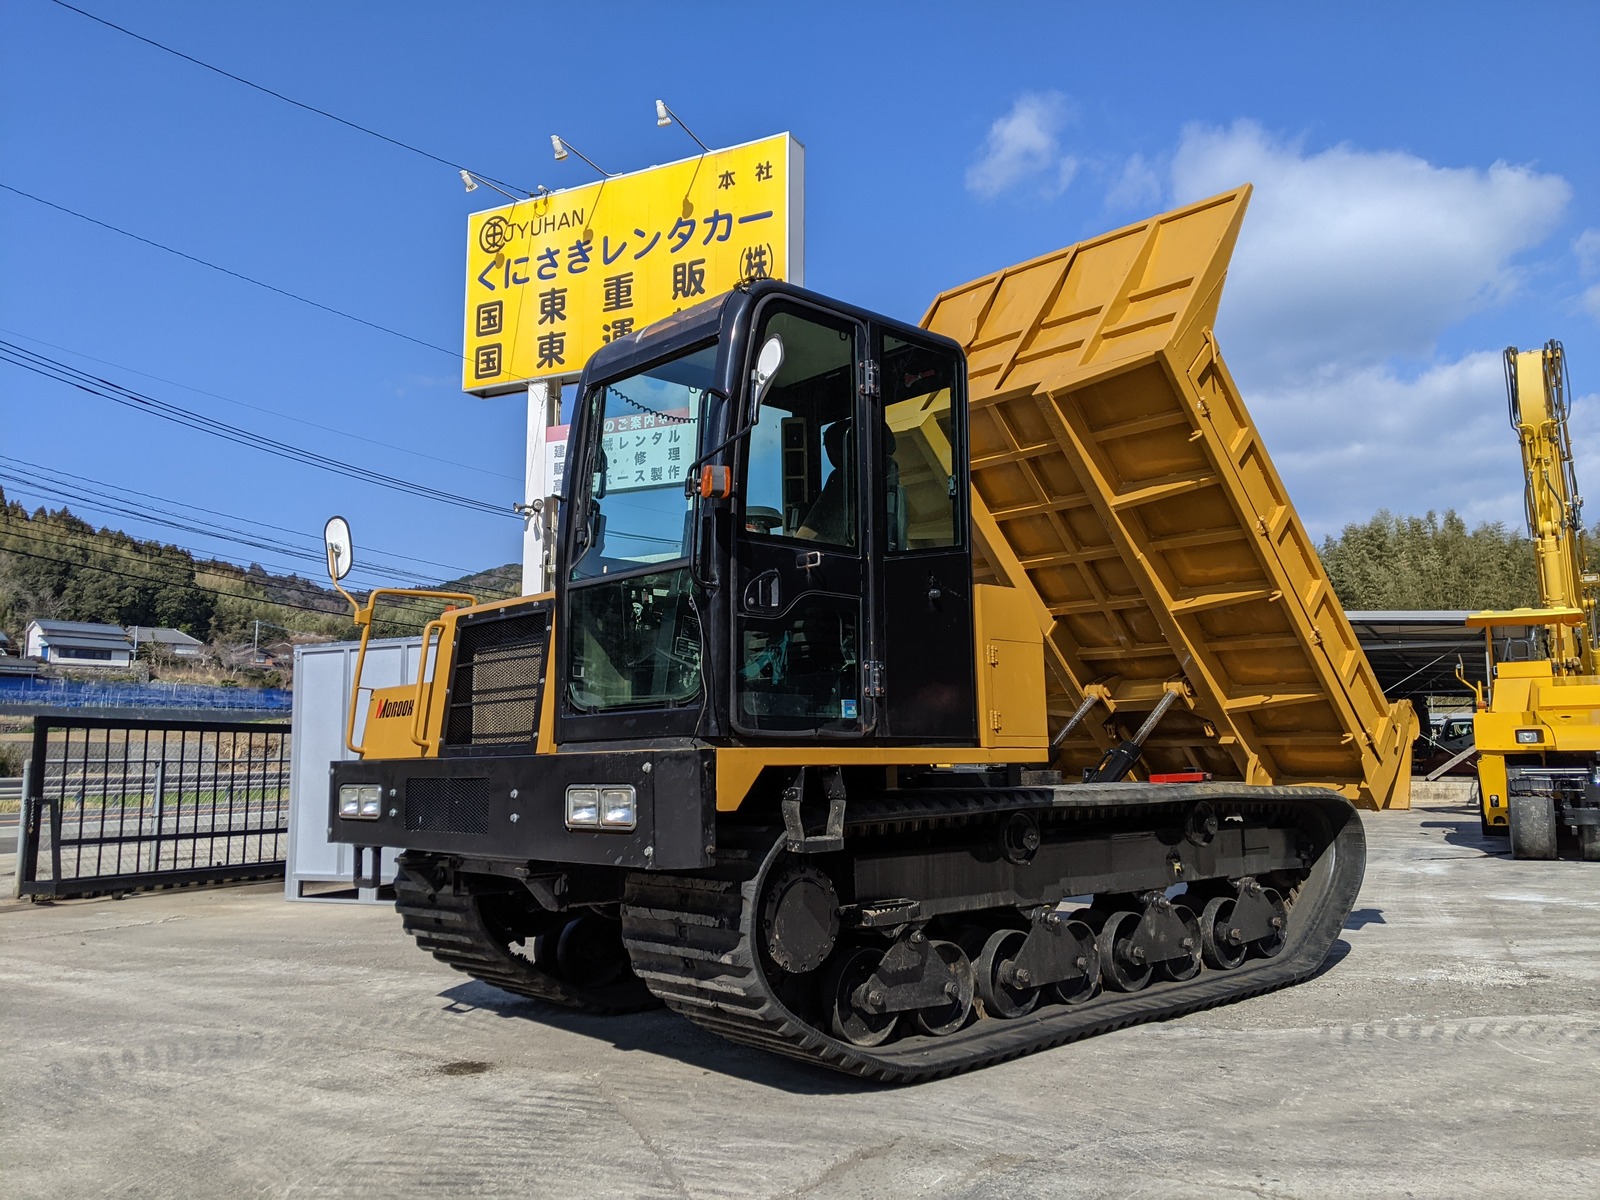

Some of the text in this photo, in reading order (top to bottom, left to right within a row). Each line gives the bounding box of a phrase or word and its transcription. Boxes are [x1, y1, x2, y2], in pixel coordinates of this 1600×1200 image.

[477, 209, 774, 292] くにさきレンタカー
[503, 208, 584, 243] JYUHAN
